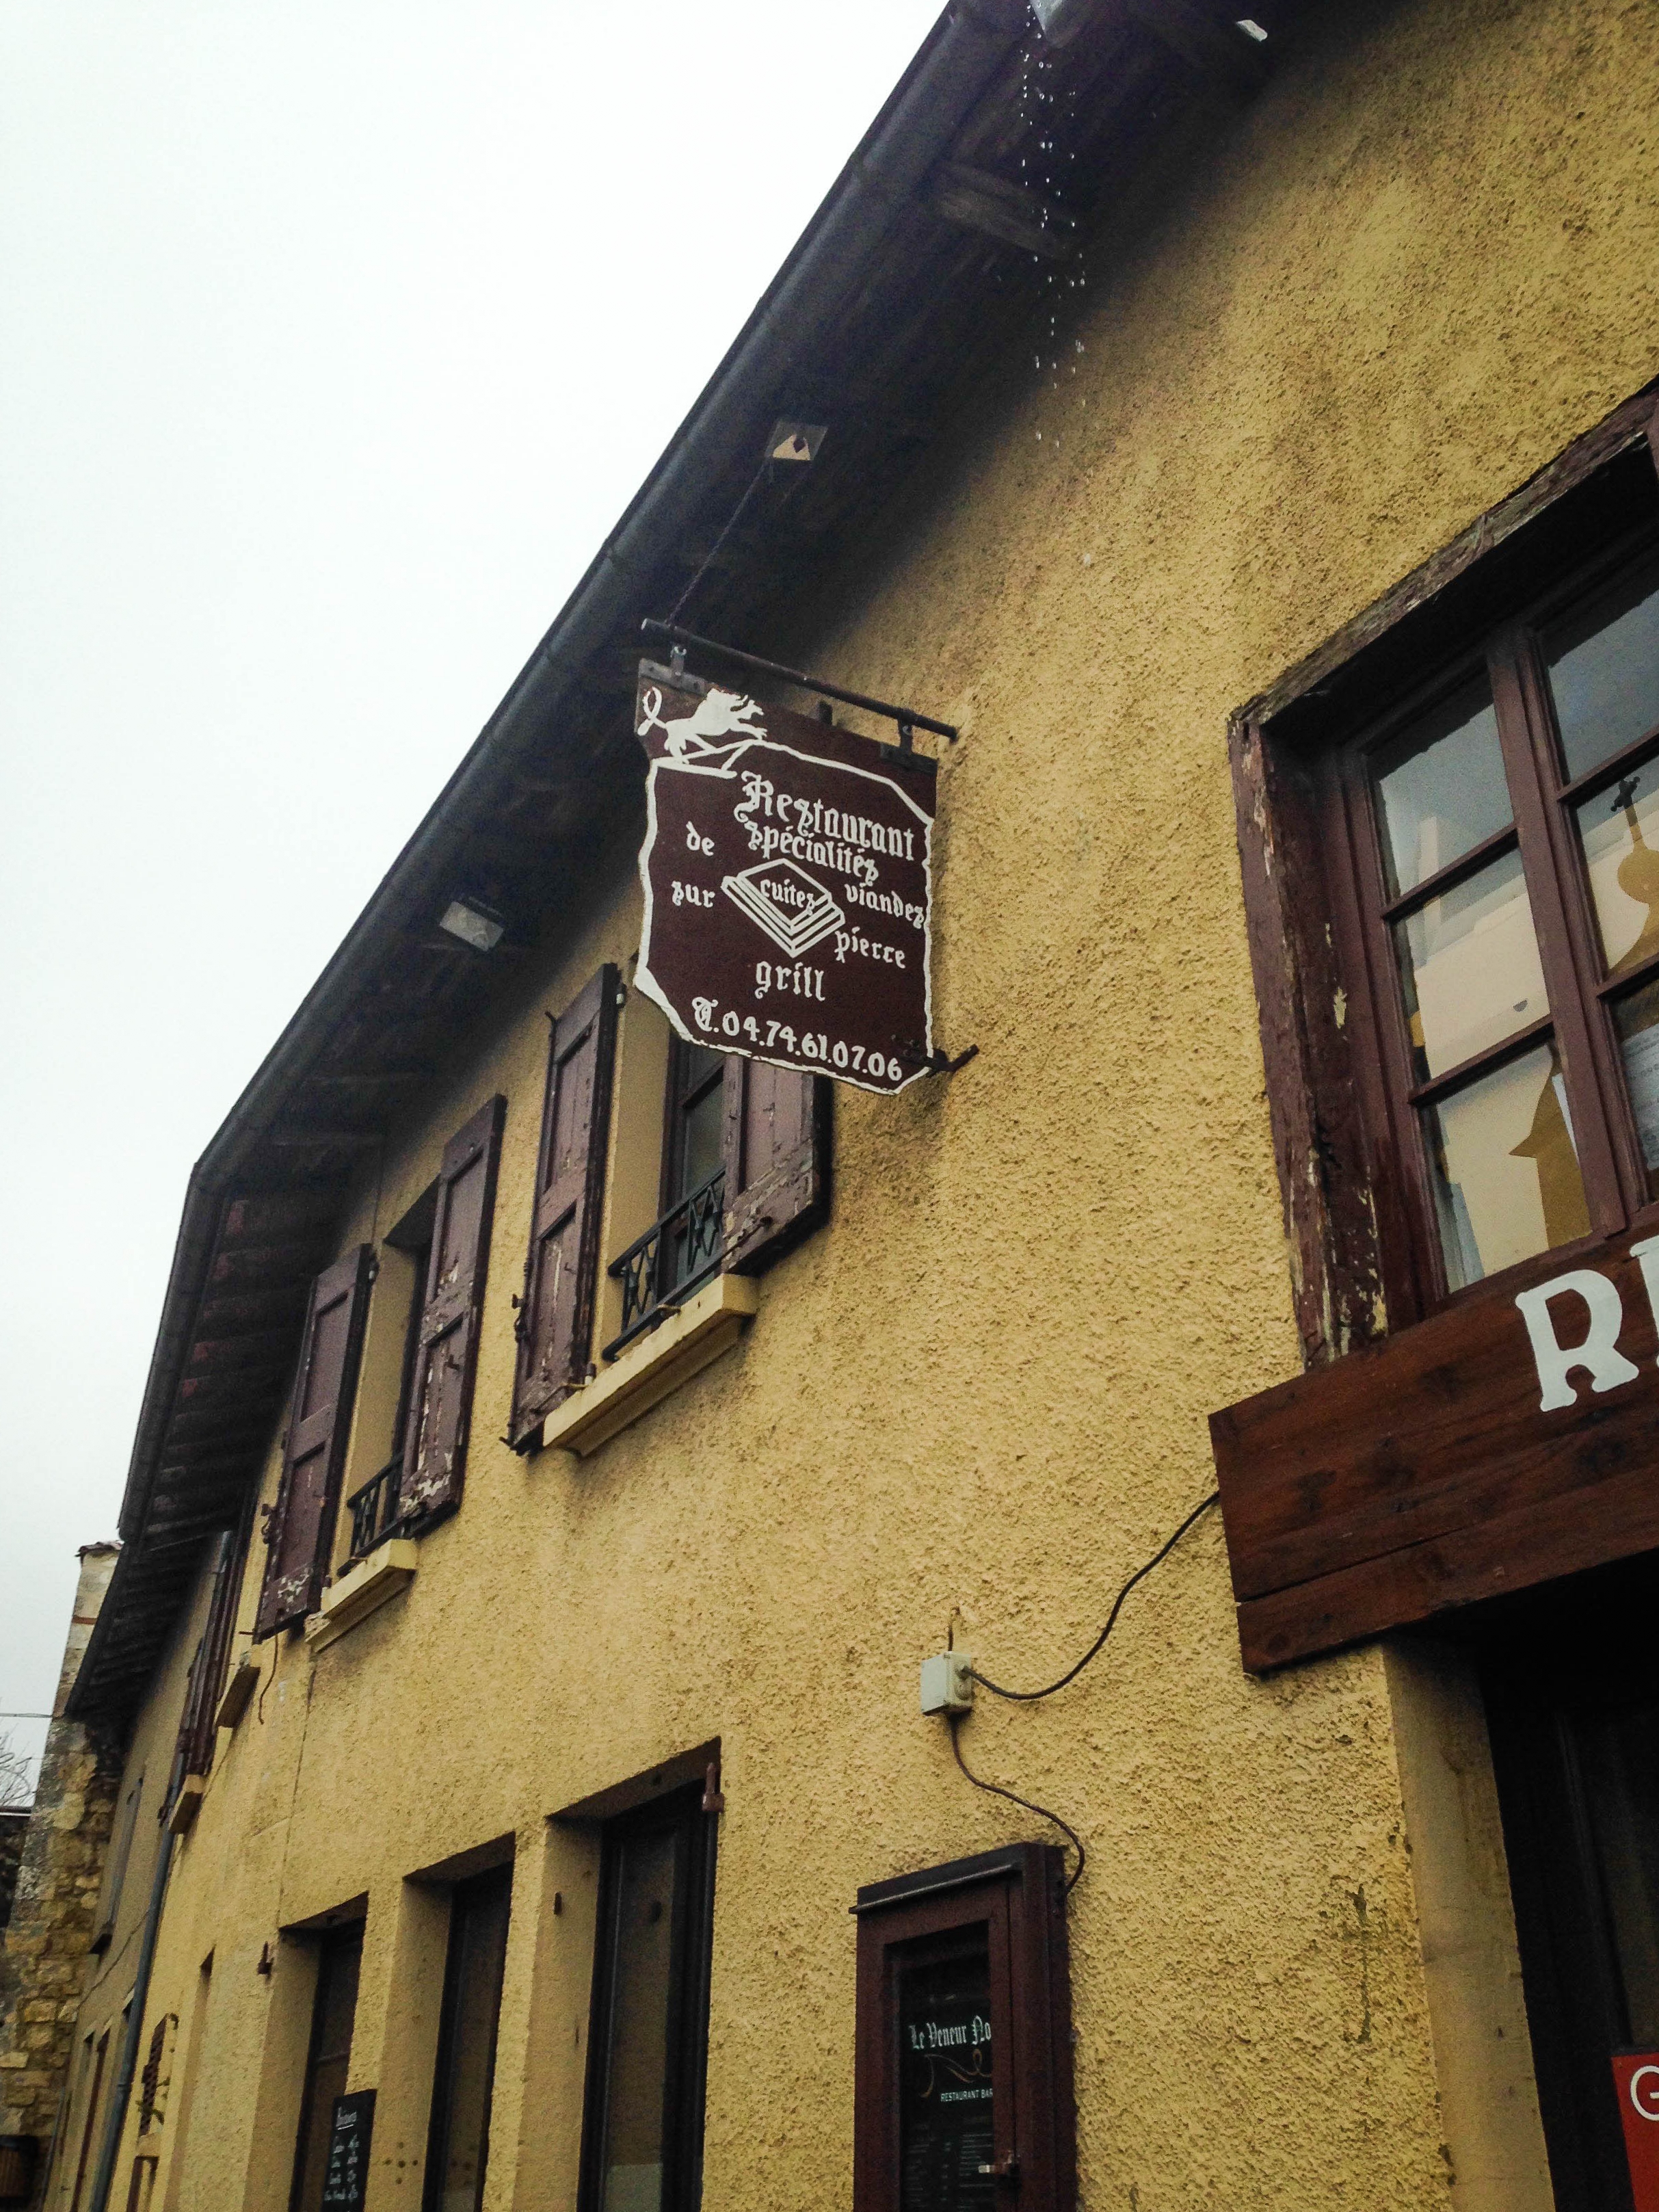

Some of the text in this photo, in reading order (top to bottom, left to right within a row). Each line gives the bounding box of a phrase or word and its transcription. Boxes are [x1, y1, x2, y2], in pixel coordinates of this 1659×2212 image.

[734, 771, 914, 861] Restaurant
[686, 821, 715, 856] de
[672, 881, 715, 908] sur
[760, 879, 817, 916] cuites
[845, 882, 925, 929] viandes
[834, 926, 906, 969] pierre
[754, 961, 825, 1001] grill
[908, 2025, 925, 2049] Le
[940, 2090, 979, 2103] RESTAURANT
